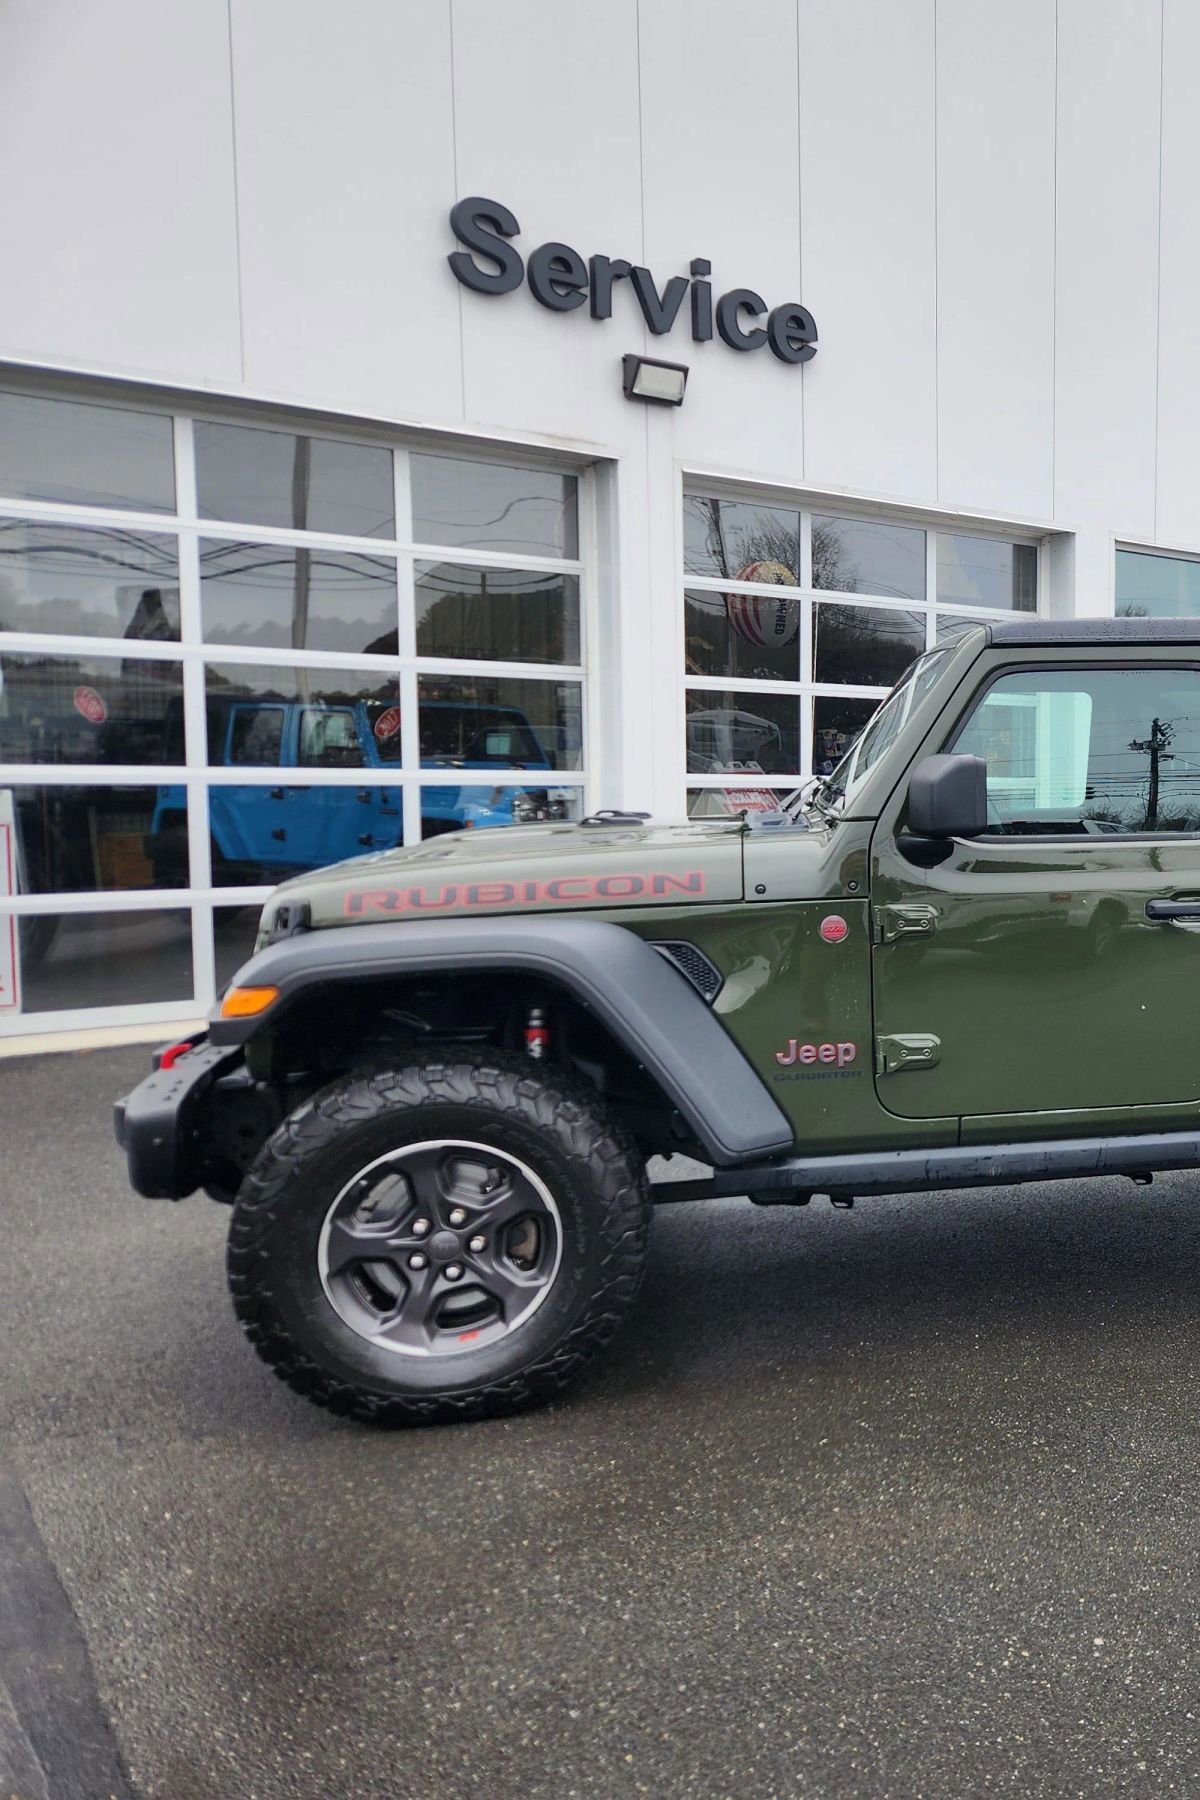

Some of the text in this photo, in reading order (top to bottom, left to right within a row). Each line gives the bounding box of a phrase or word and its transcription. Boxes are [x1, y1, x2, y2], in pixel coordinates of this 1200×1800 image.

[447, 196, 818, 364] Service
[344, 871, 705, 917] RUBICON
[775, 1039, 857, 1067] Jeep
[773, 1070, 863, 1082] GLADIATOR
